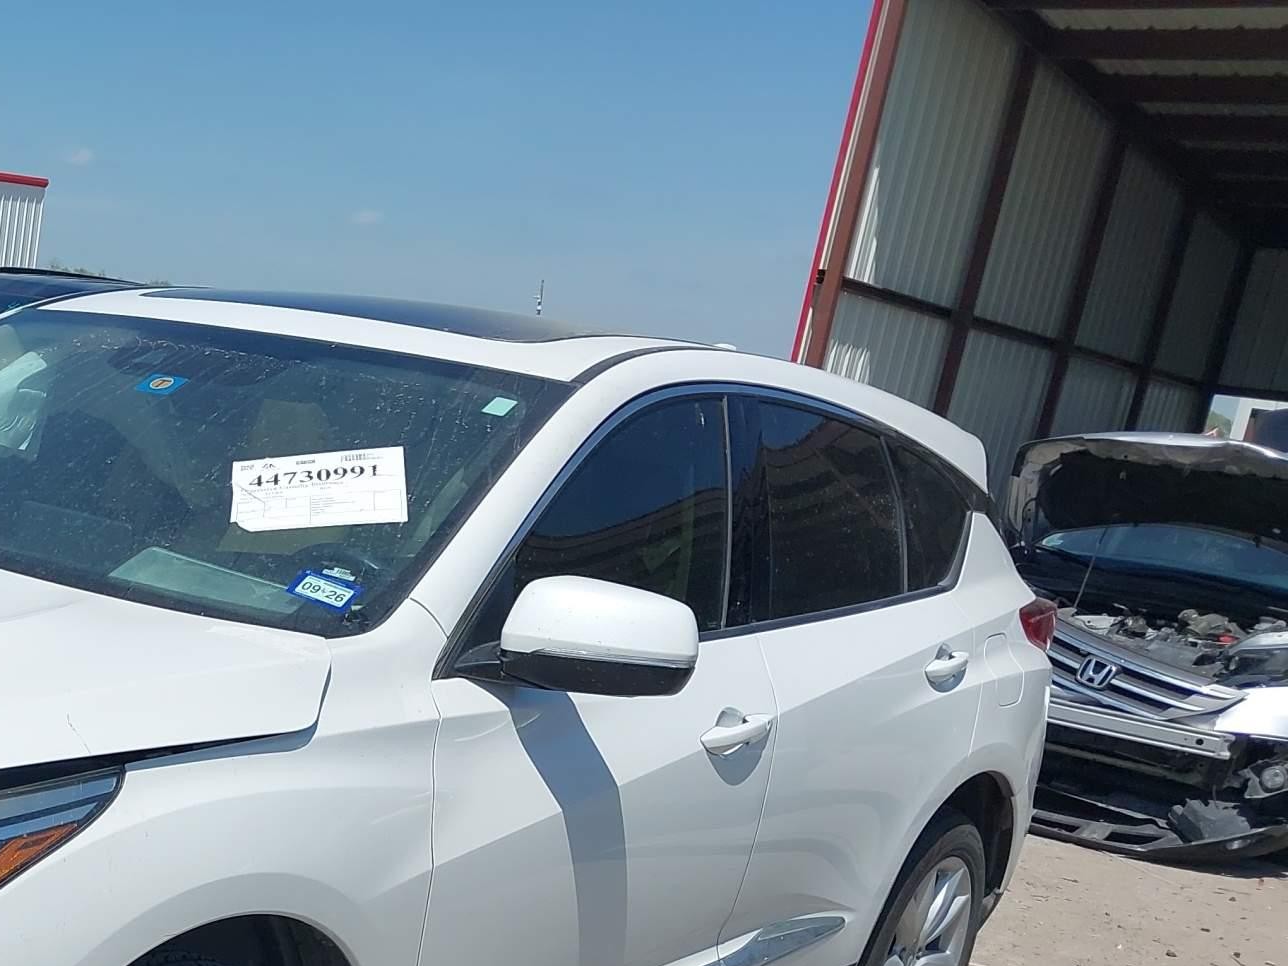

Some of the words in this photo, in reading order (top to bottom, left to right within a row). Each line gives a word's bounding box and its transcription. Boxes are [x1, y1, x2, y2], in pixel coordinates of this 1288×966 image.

[248, 464, 378, 487] 44730991
[301, 581, 322, 594] 09
[324, 590, 347, 603] 26
